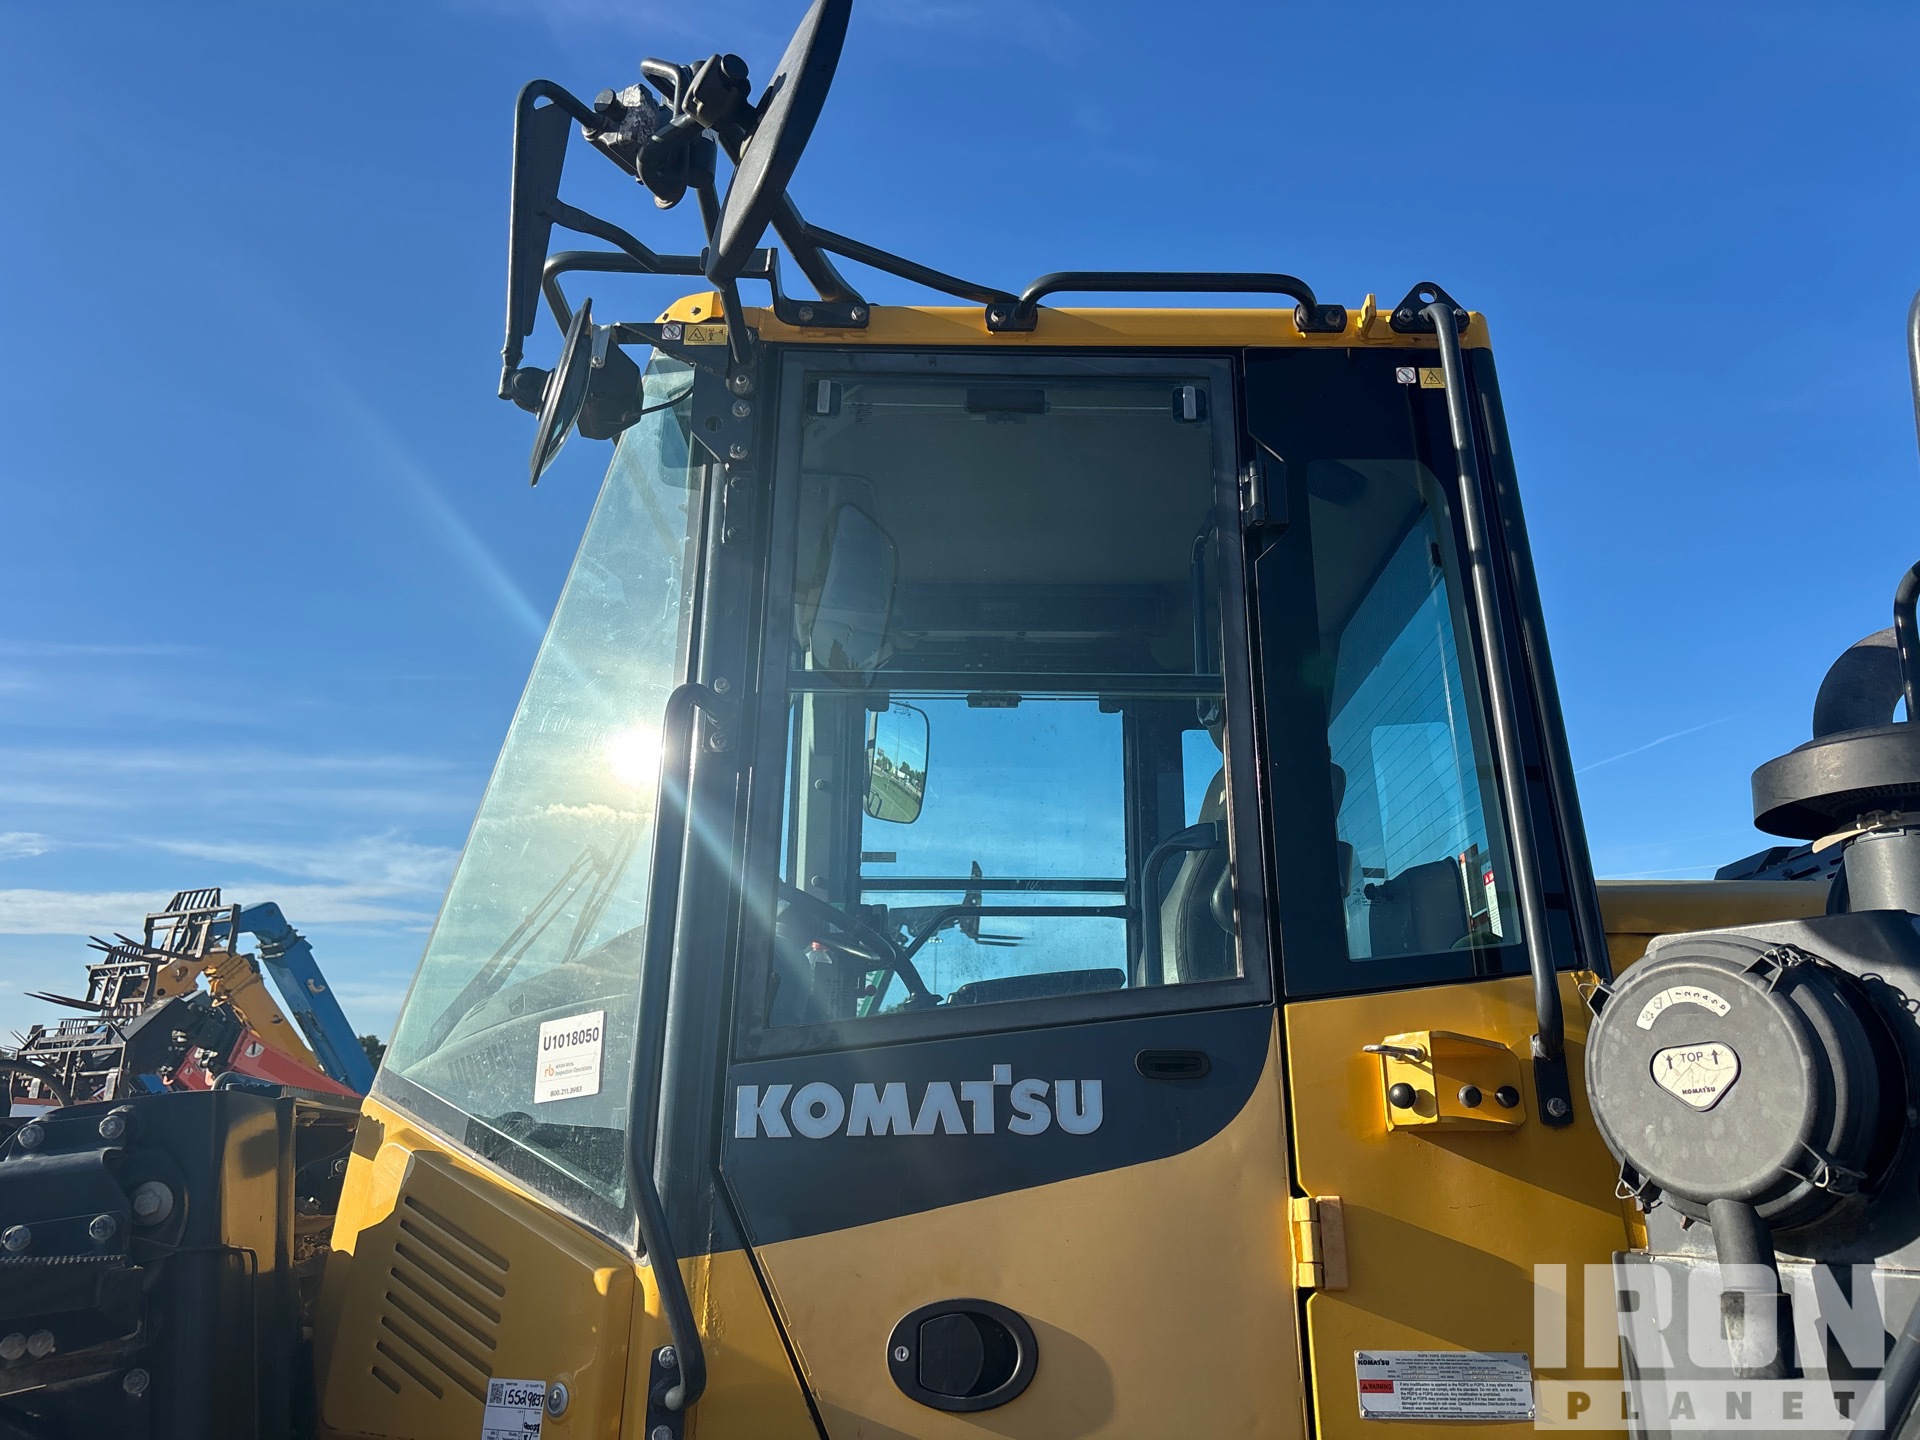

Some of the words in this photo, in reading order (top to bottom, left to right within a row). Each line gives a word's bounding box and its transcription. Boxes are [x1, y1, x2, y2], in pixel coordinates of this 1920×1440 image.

[543, 1026, 600, 1051] U1018050
[1680, 1052, 1704, 1063] TOP
[550, 1086, 582, 1098] 800.211.3983
[1682, 1086, 1716, 1095] KOMATSU
[734, 1064, 1104, 1139] KOMATSU
[503, 1389, 545, 1407] 15529837
